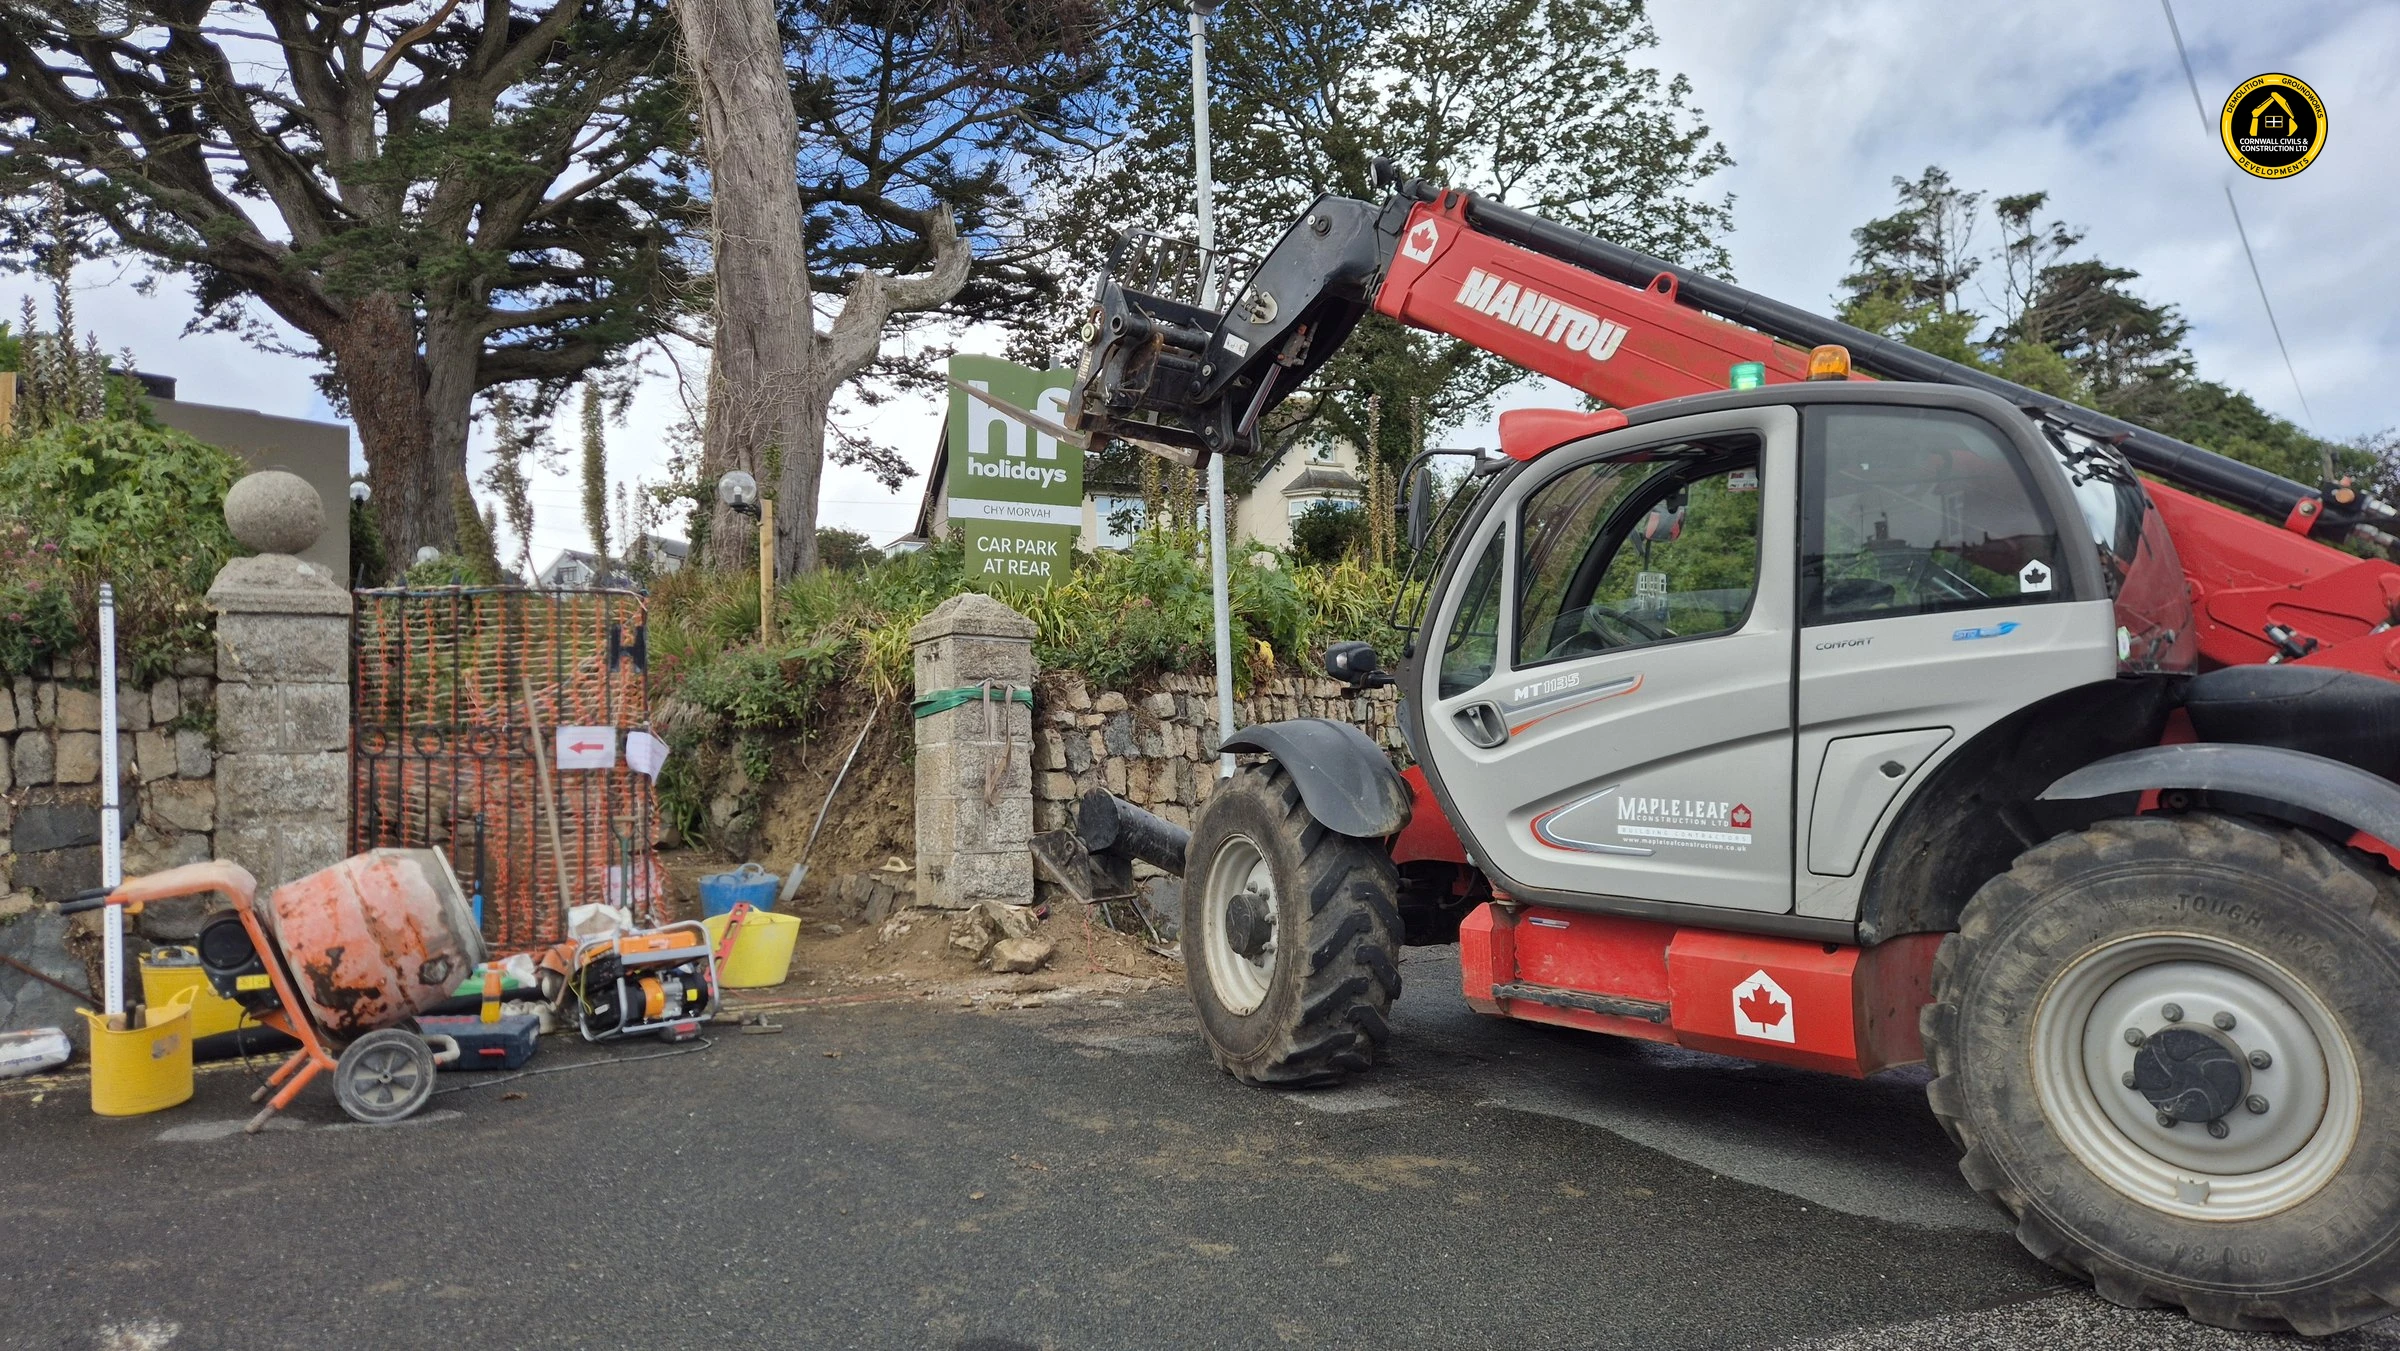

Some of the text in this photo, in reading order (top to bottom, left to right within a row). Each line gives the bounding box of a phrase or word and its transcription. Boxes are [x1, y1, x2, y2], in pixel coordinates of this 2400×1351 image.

[1454, 266, 1632, 361] MANITOU
[967, 456, 1068, 489] holidays
[983, 504, 1052, 518] CHY MORVAH
[976, 536, 1059, 557] CAR PARK
[983, 558, 1051, 577] AT REAR
[1815, 636, 1875, 651] COMFORT
[1617, 796, 1729, 821] MAPLE LEAF
[1636, 814, 1729, 827] CONSTRUCTION LTD
[1621, 827, 1747, 843] BUILDING CONTRACTORS
[1622, 836, 1747, 852] www.mapleleafconstruction.co.uk
[2177, 892, 2264, 929] TOUGH
